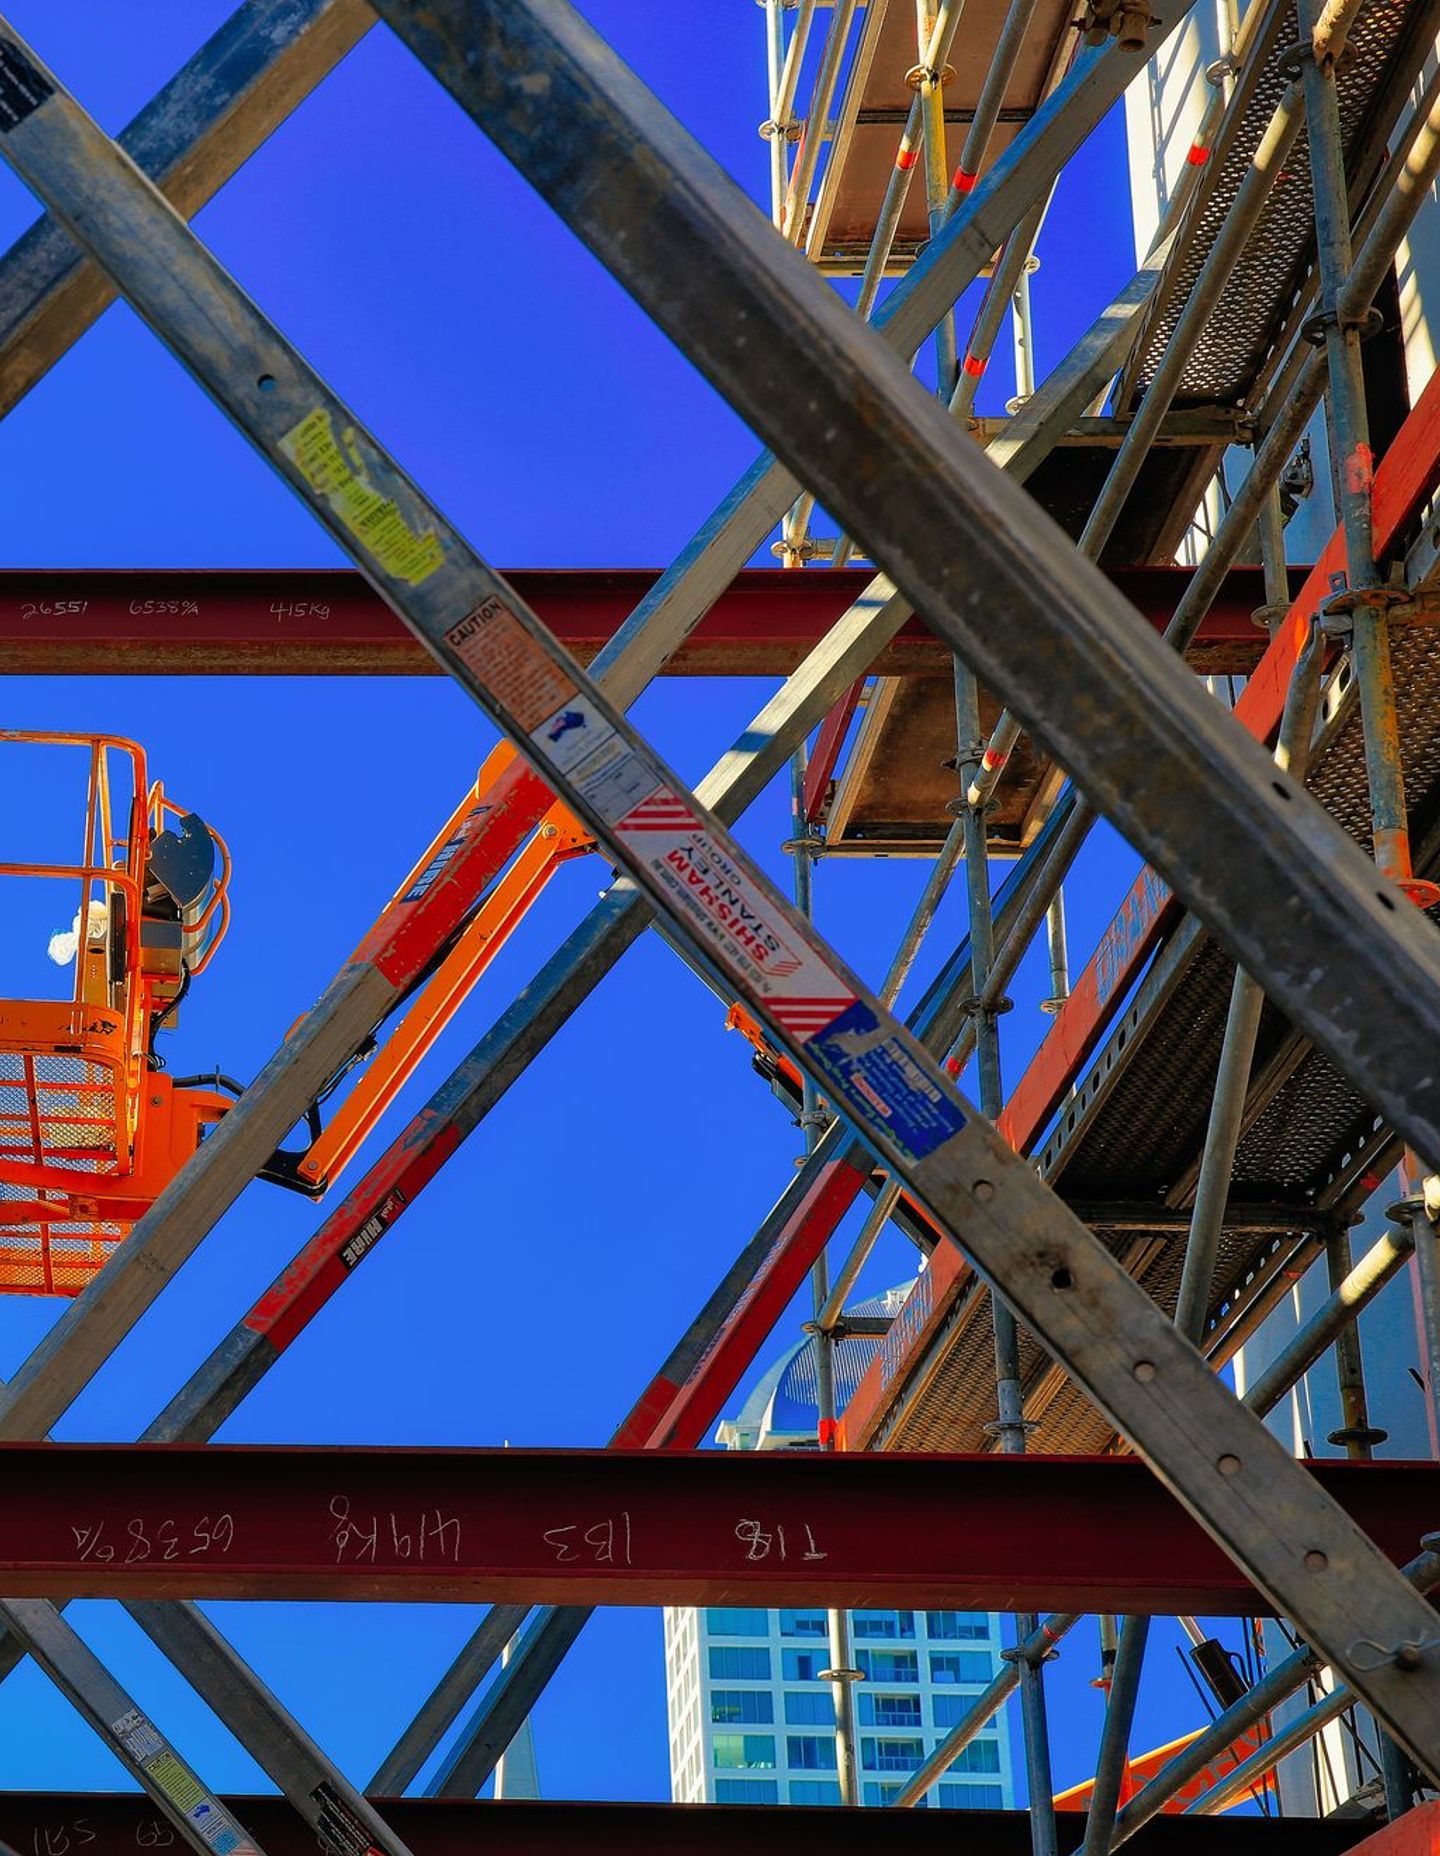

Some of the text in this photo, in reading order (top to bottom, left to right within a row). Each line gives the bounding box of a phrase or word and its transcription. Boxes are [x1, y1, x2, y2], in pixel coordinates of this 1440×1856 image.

[21, 601, 88, 620] 26551
[269, 601, 331, 622] 415Kg
[449, 599, 503, 648] CAUTION
[406, 844, 460, 897] HIRE
[690, 830, 744, 888] GROUP
[665, 848, 771, 964] SHISHAM
[678, 841, 782, 953] STANLEY
[851, 1073, 892, 1116] WARNING
[341, 1217, 384, 1266] HIRE
[544, 1511, 631, 1565] 1B3
[734, 1518, 828, 1561] T18
